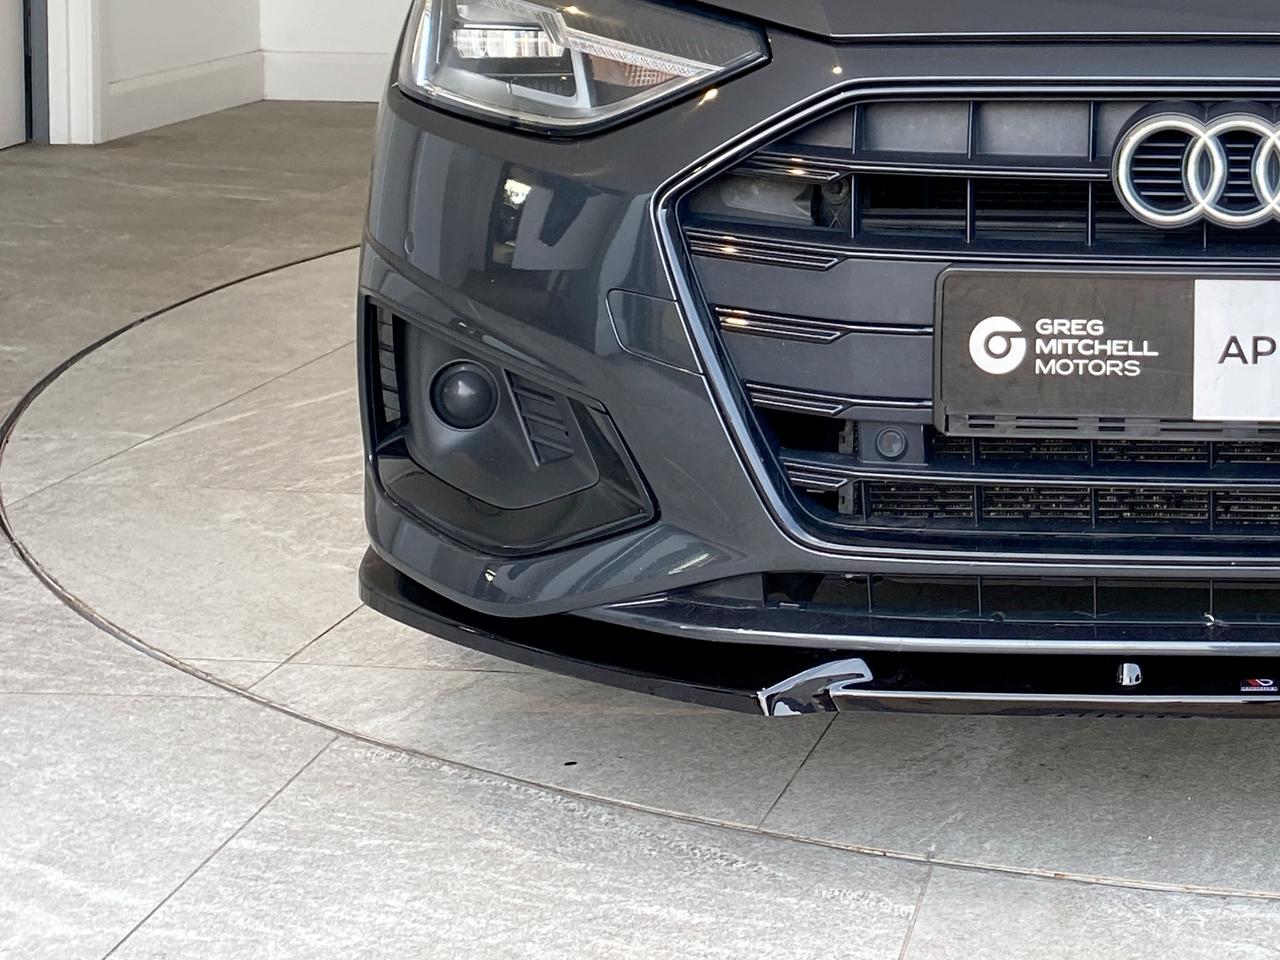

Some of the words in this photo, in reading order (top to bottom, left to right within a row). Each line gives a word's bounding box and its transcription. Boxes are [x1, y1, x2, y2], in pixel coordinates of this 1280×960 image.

[1035, 318, 1105, 337] GREG
[1035, 338, 1160, 357] MITCHELL
[1035, 359, 1141, 377] MOTORS
